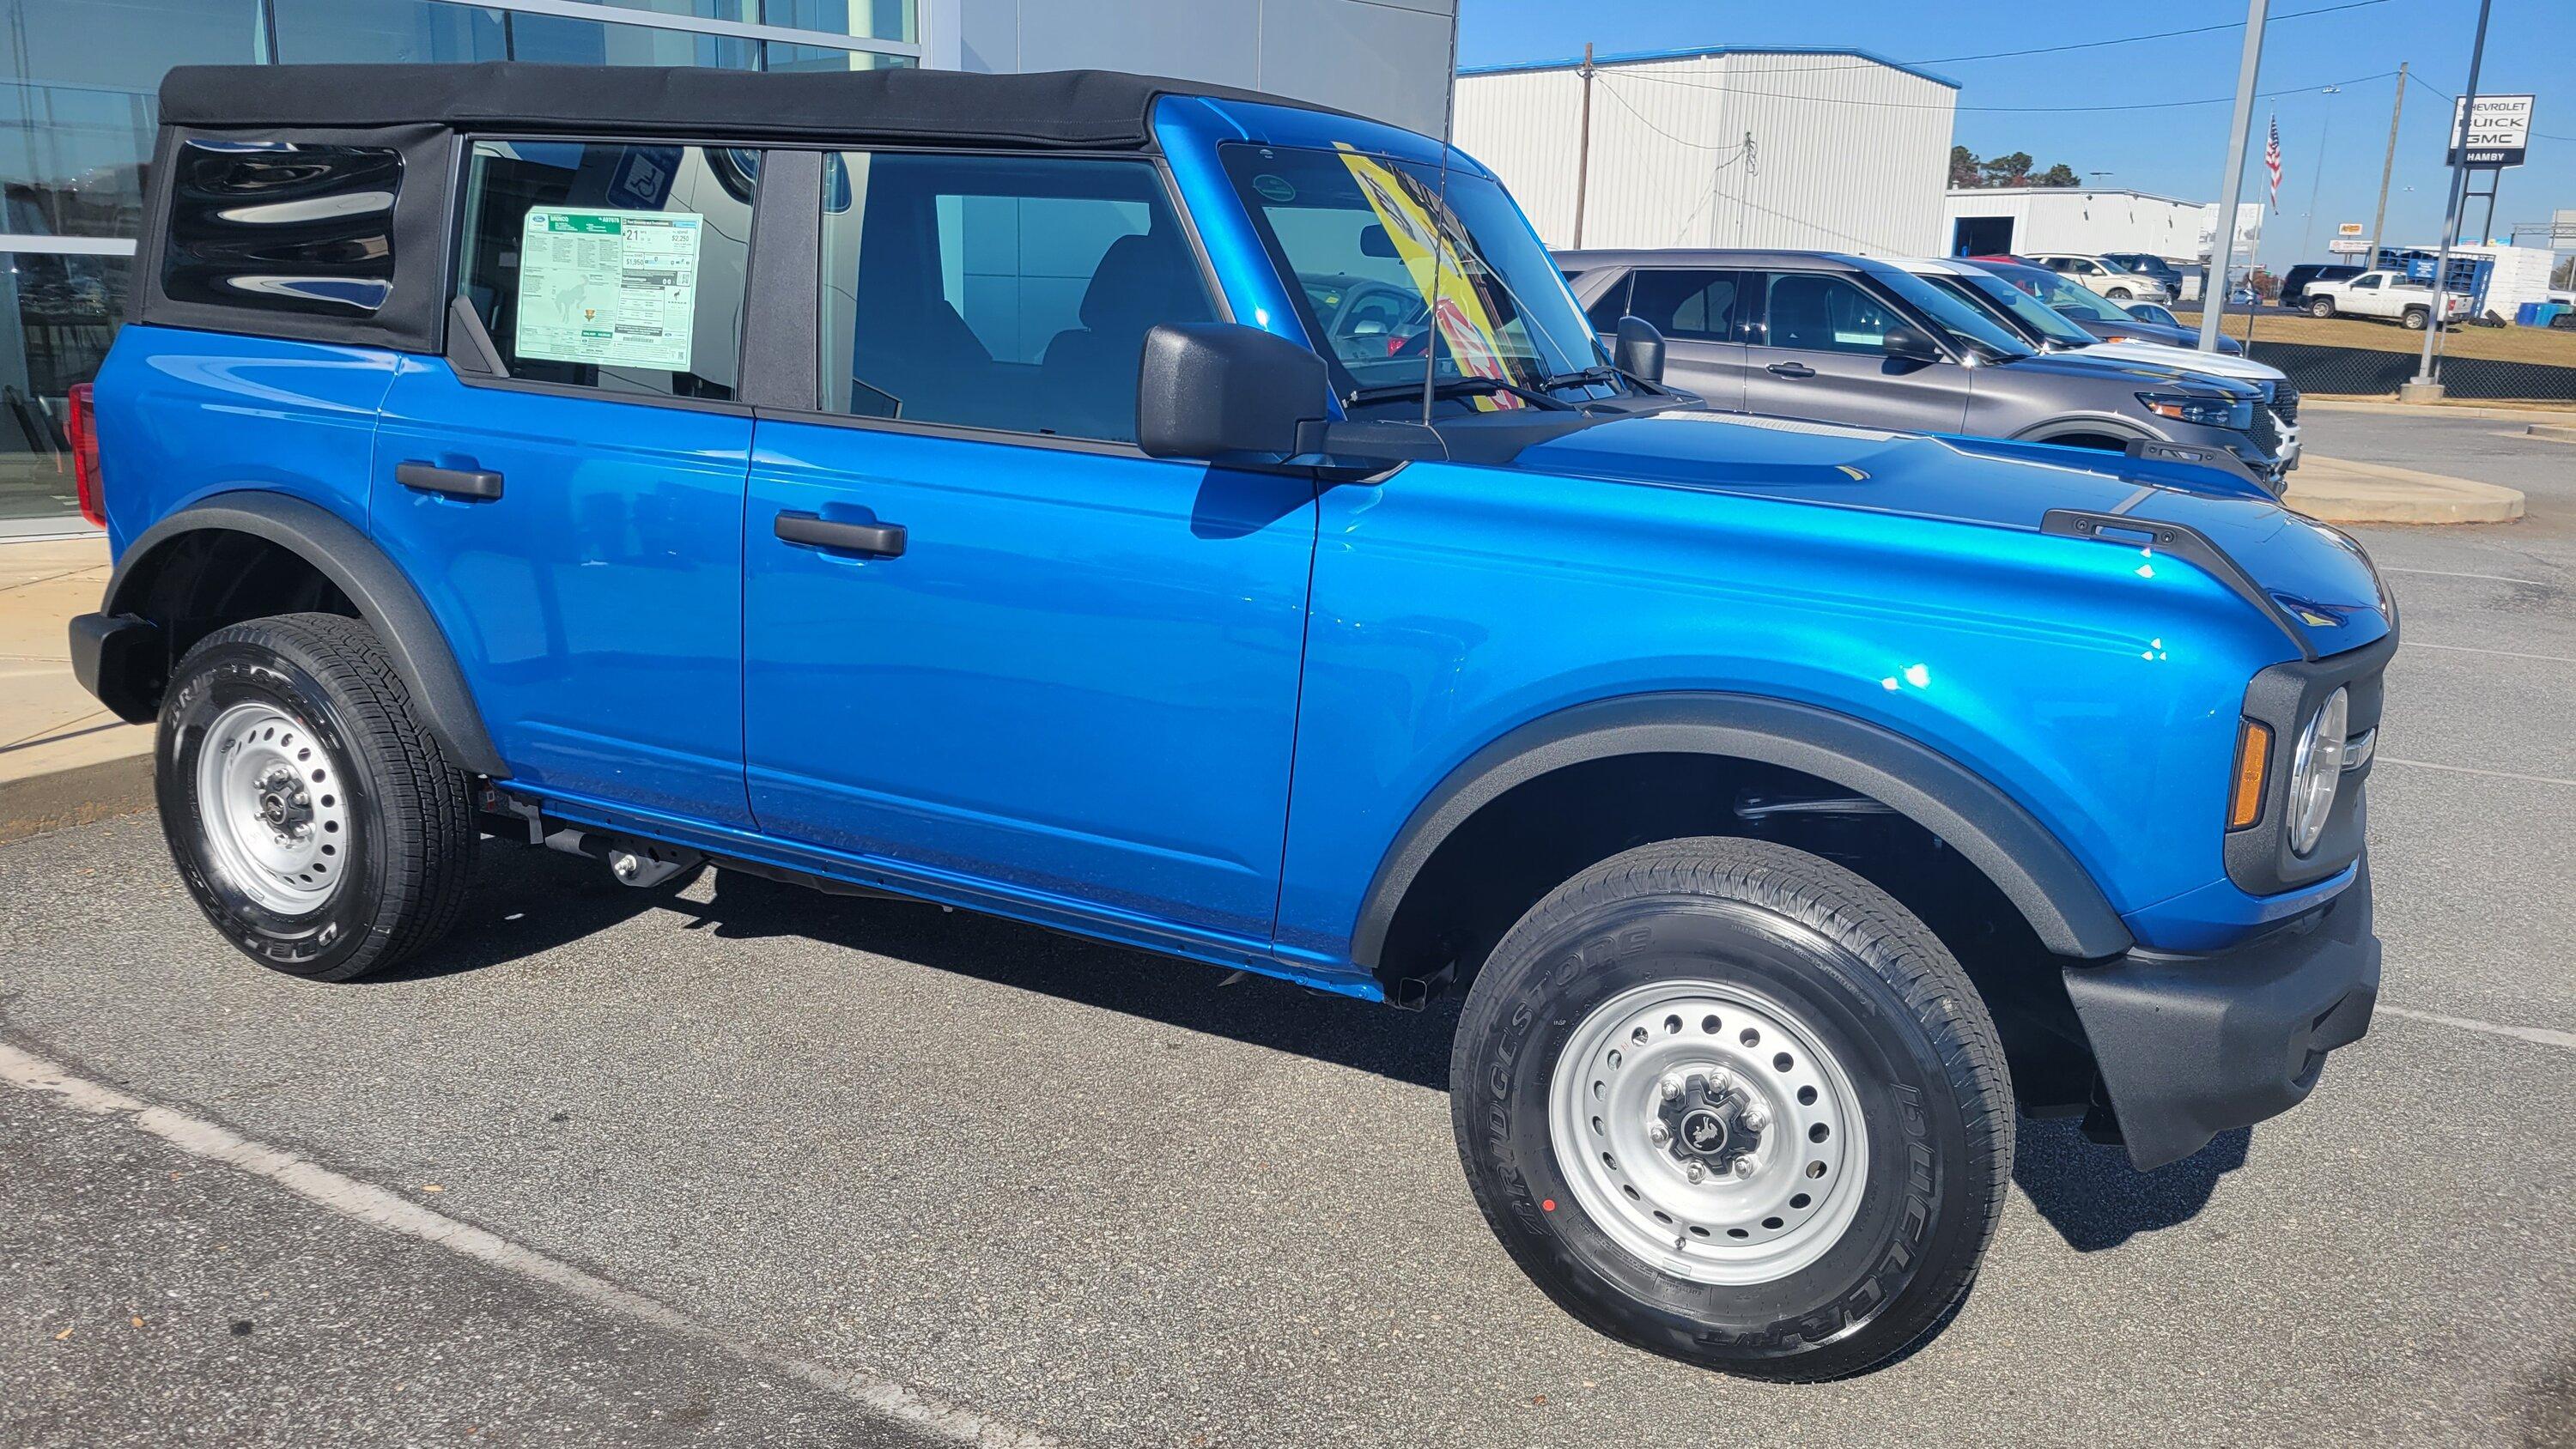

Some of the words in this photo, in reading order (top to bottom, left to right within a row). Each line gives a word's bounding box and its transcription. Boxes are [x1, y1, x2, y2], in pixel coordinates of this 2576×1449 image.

[2463, 102, 2526, 112] HEVROLET
[2466, 153, 2505, 161] HAMBY
[626, 229, 639, 241] 21
